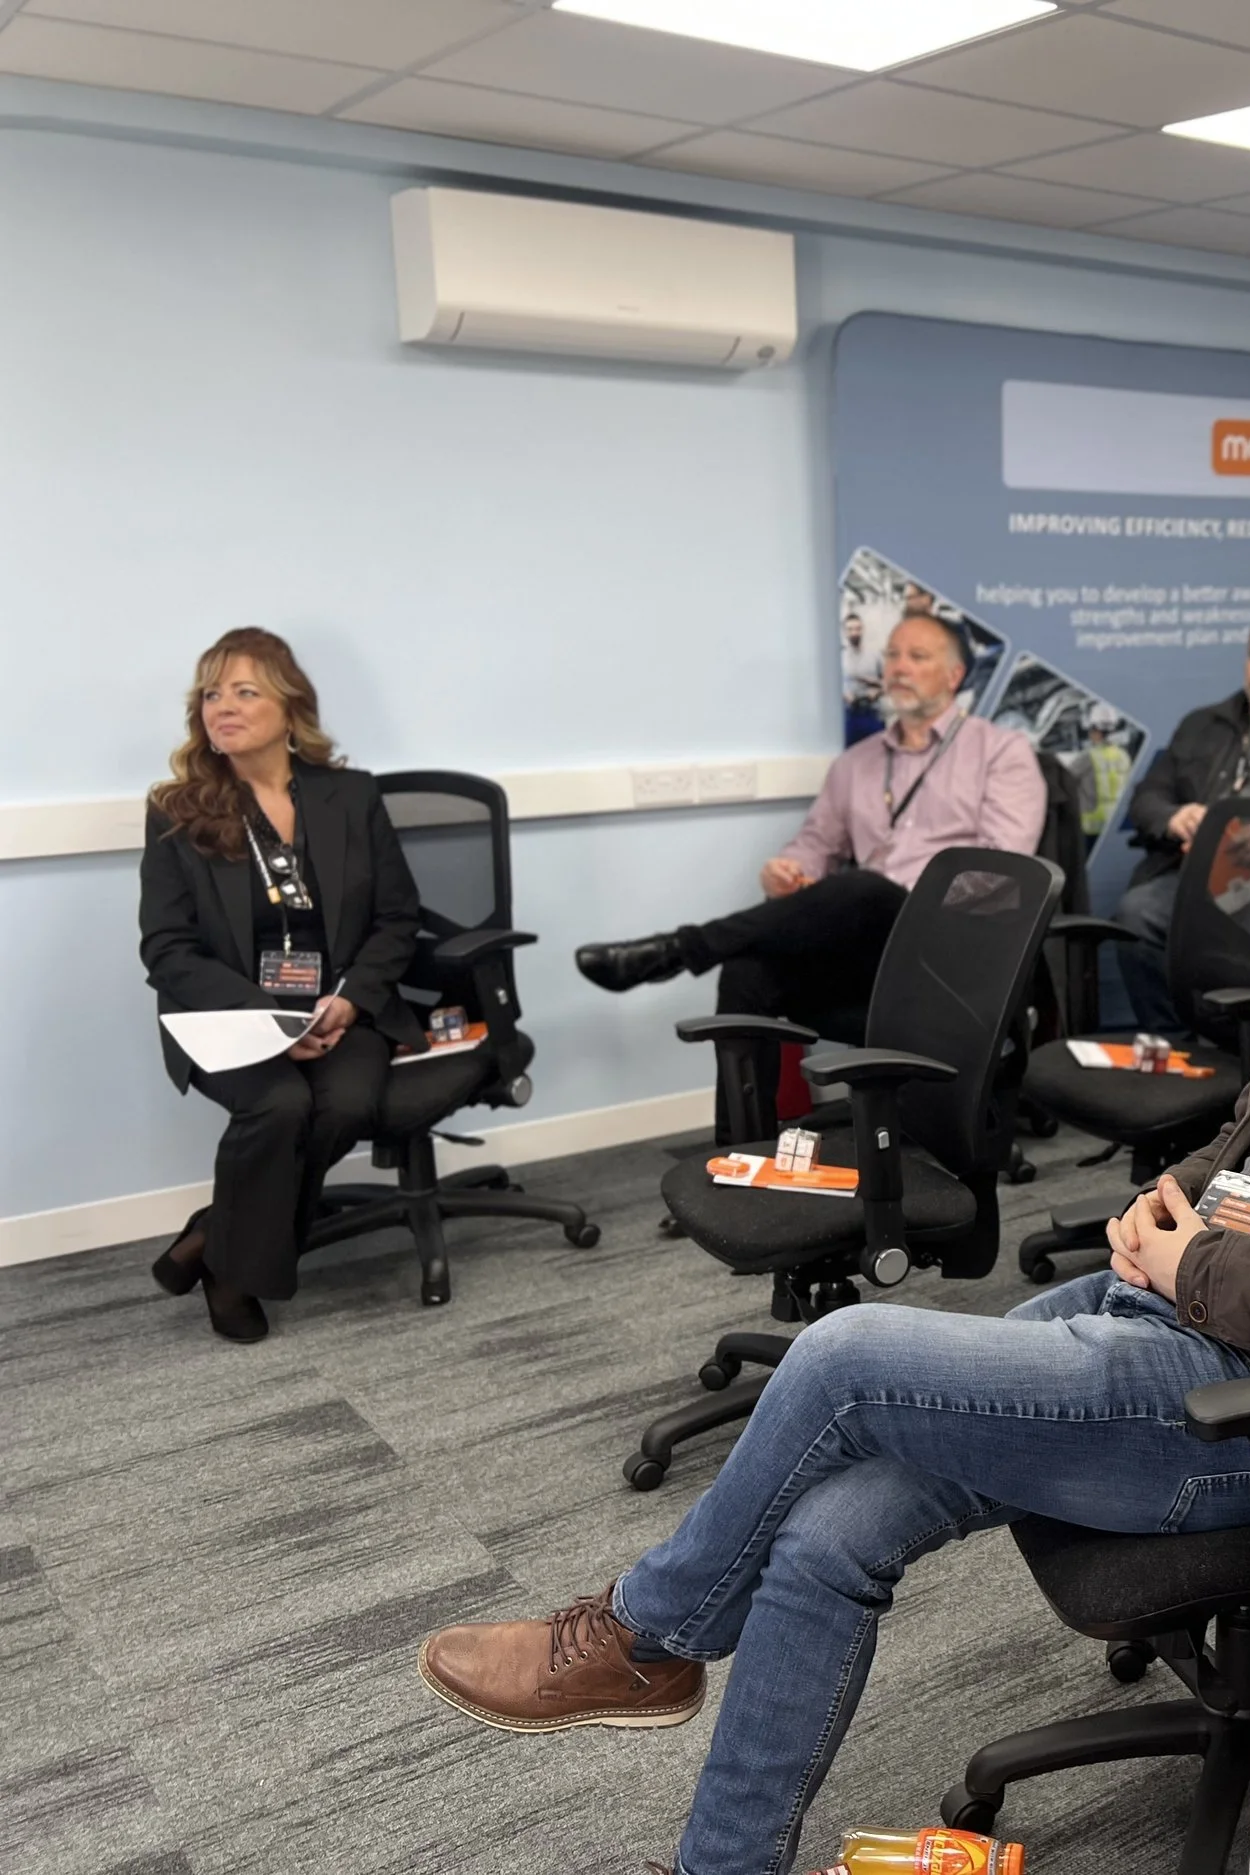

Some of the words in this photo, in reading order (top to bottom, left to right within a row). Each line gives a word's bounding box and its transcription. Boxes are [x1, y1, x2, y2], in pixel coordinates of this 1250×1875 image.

[1009, 513, 1121, 536] IMPROVING
[1125, 516, 1225, 543] EFFICIENCY,
[976, 583, 1043, 608] helping
[1046, 588, 1079, 607] you
[1081, 585, 1100, 603] to
[1102, 584, 1167, 605] develop
[1182, 583, 1228, 602] better
[1070, 608, 1146, 629] strengths
[1150, 607, 1180, 625] and
[1076, 629, 1183, 652] improvement
[1185, 628, 1219, 650] plan
